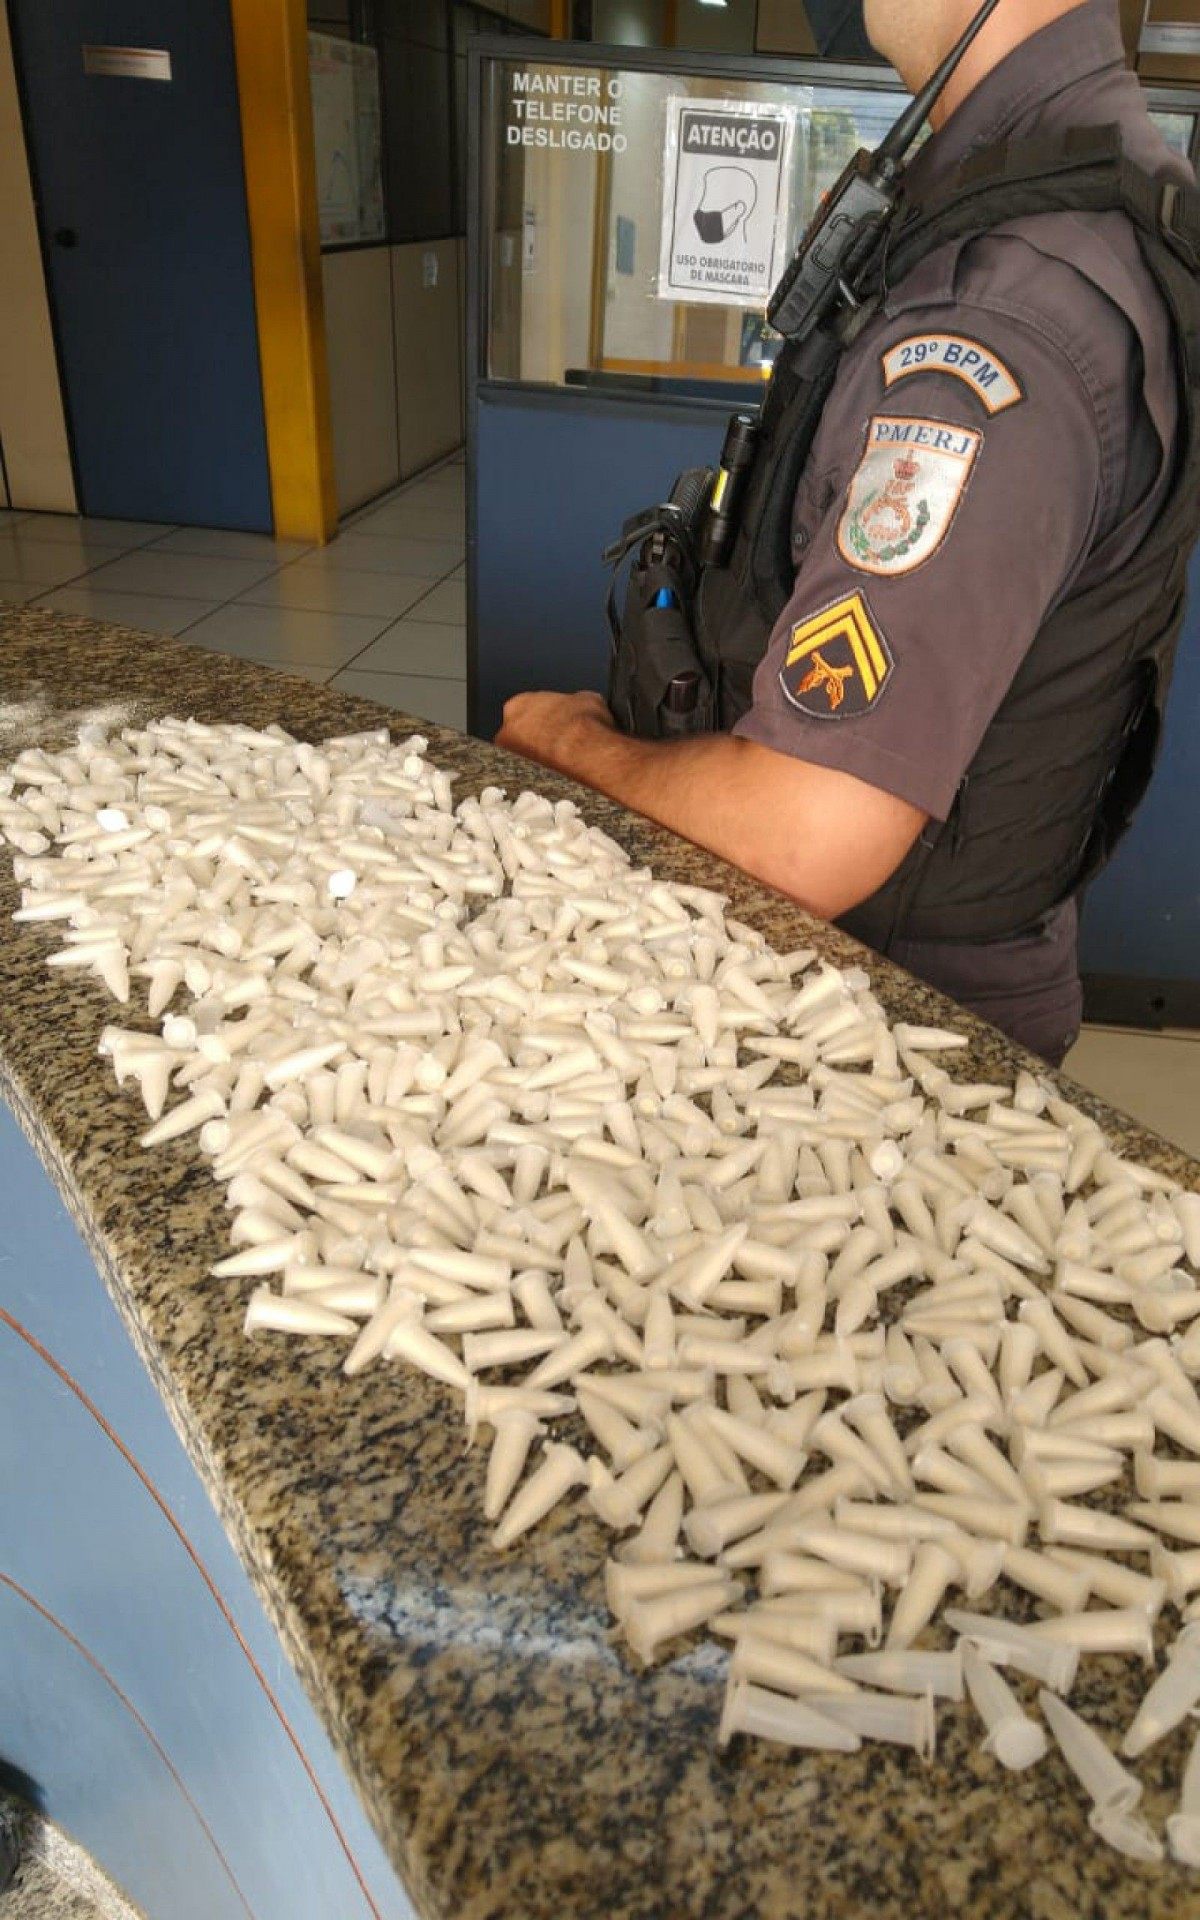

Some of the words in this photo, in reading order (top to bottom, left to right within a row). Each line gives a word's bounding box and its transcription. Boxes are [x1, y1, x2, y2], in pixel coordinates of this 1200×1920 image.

[513, 73, 601, 96] MANTER
[607, 79, 623, 99] O
[513, 99, 623, 125] TELEFONE
[507, 127, 628, 152] DESLIGADO
[688, 124, 776, 153] ATENÇÃO
[676, 255, 698, 266] USO
[690, 270, 702, 280] DE
[943, 344, 999, 388] BPM
[875, 424, 972, 453] PMERJ
